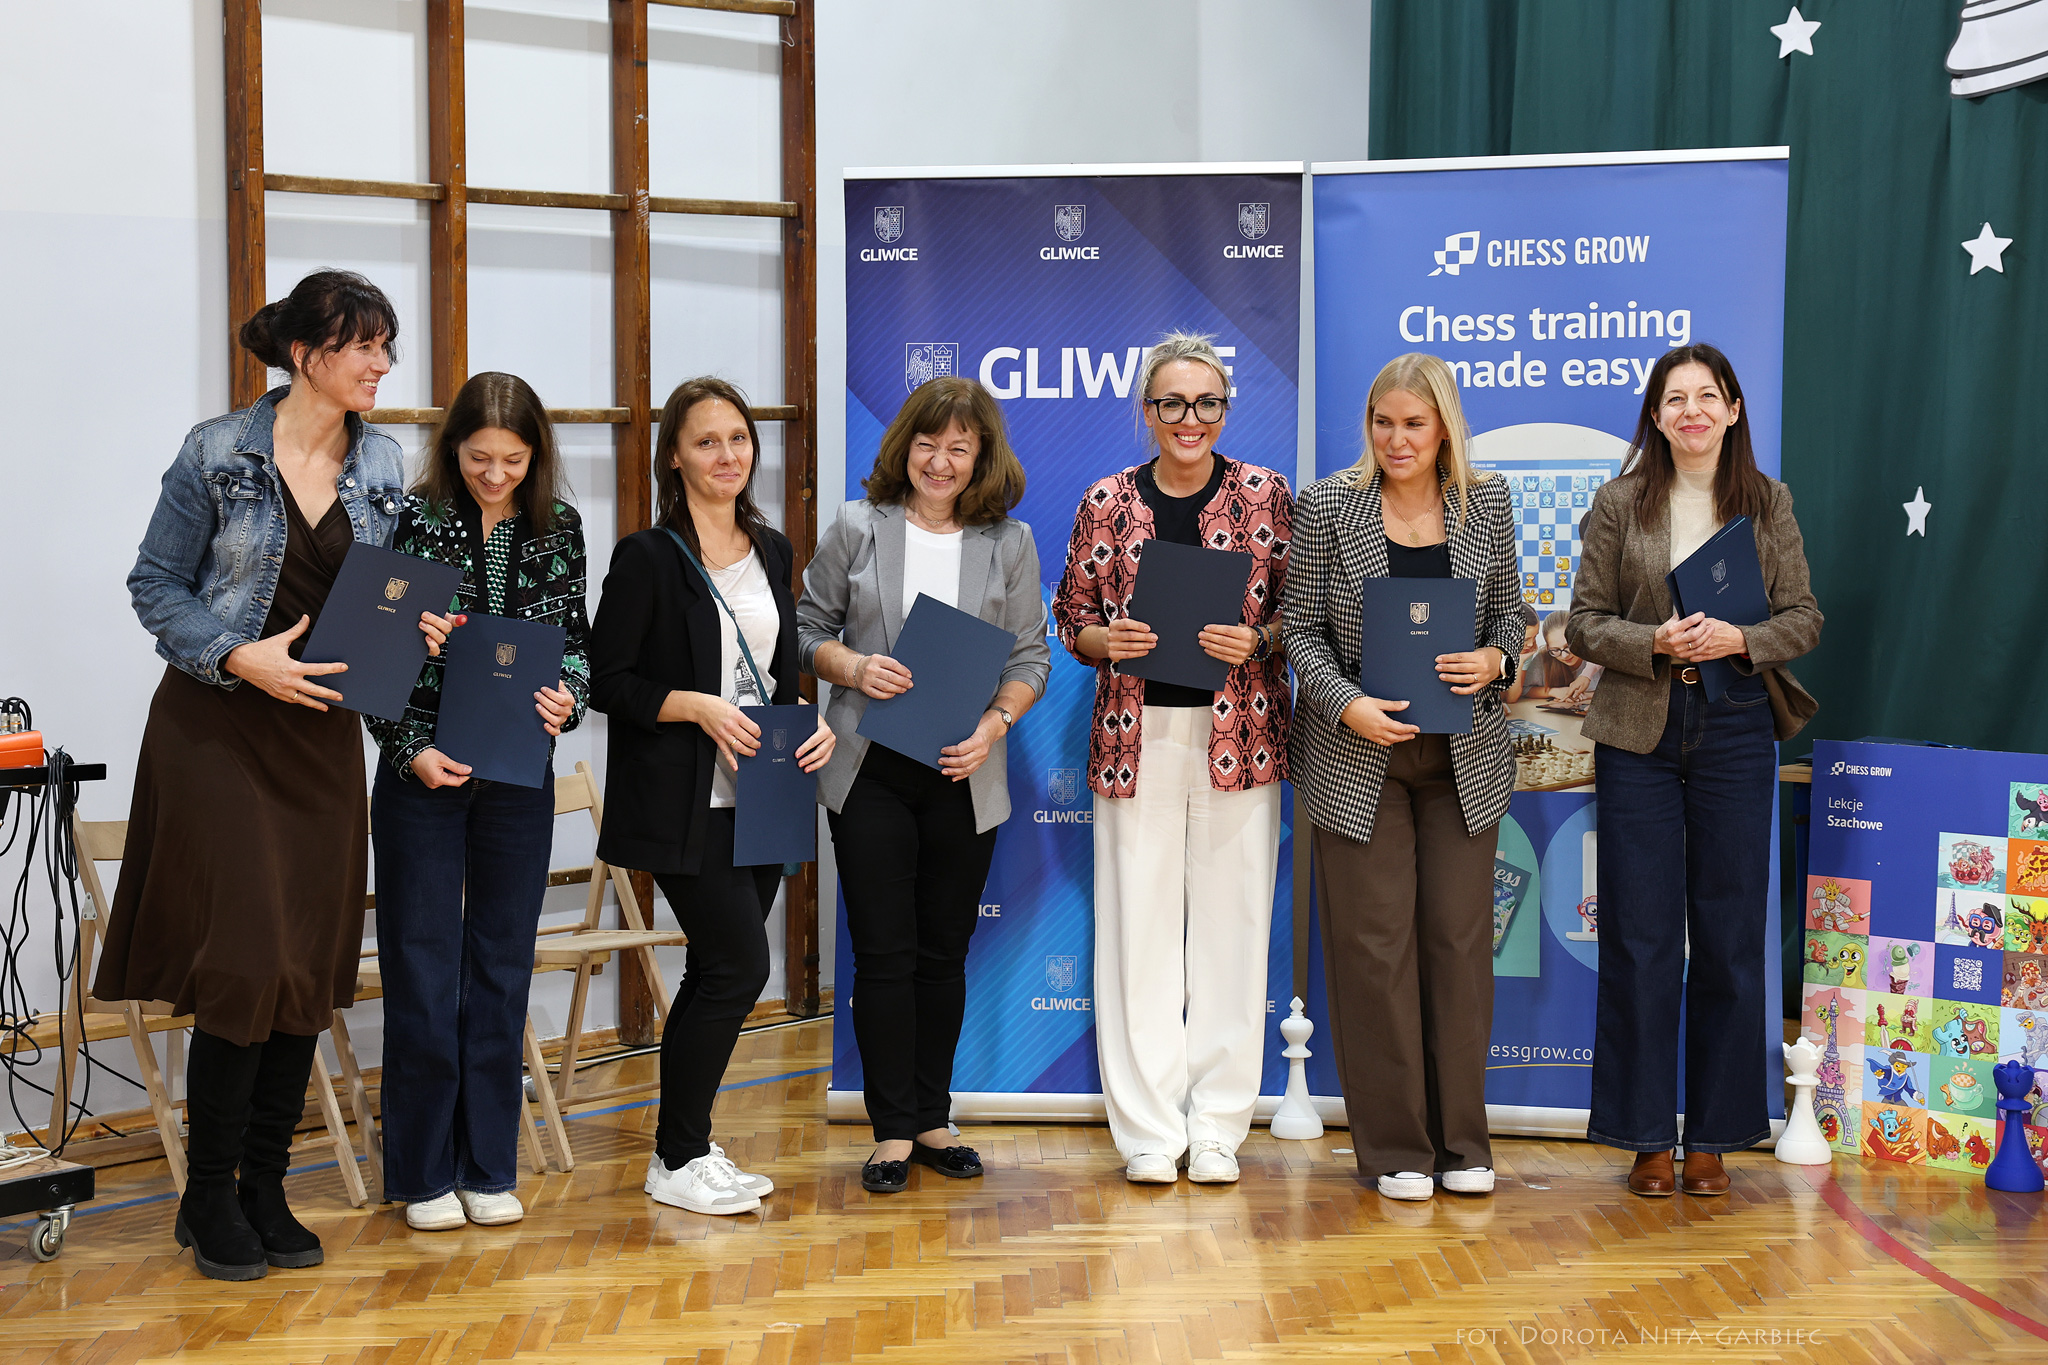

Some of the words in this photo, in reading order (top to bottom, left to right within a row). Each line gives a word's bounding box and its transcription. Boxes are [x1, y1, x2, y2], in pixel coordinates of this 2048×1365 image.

[860, 248, 918, 262] GLIWICE
[1039, 247, 1100, 260] GLIWICE
[1223, 245, 1284, 259] GLIWICE
[1487, 238, 1567, 268] CHESS
[1574, 235, 1650, 265] GROW
[1399, 305, 1516, 343] Chess
[1529, 301, 1691, 347] training
[979, 346, 1237, 400] GLIW
[1561, 357, 1657, 395] easy
[1846, 764, 1869, 776] CHESS
[1870, 766, 1893, 777] GROW
[1828, 796, 1864, 813] Lekcje
[1033, 810, 1093, 824] GLIWICE
[1827, 814, 1883, 831] Szachowe
[1493, 864, 1521, 887] ess
[1030, 997, 1091, 1011] GLIWICE
[1487, 1044, 1593, 1063] essgrow.co
